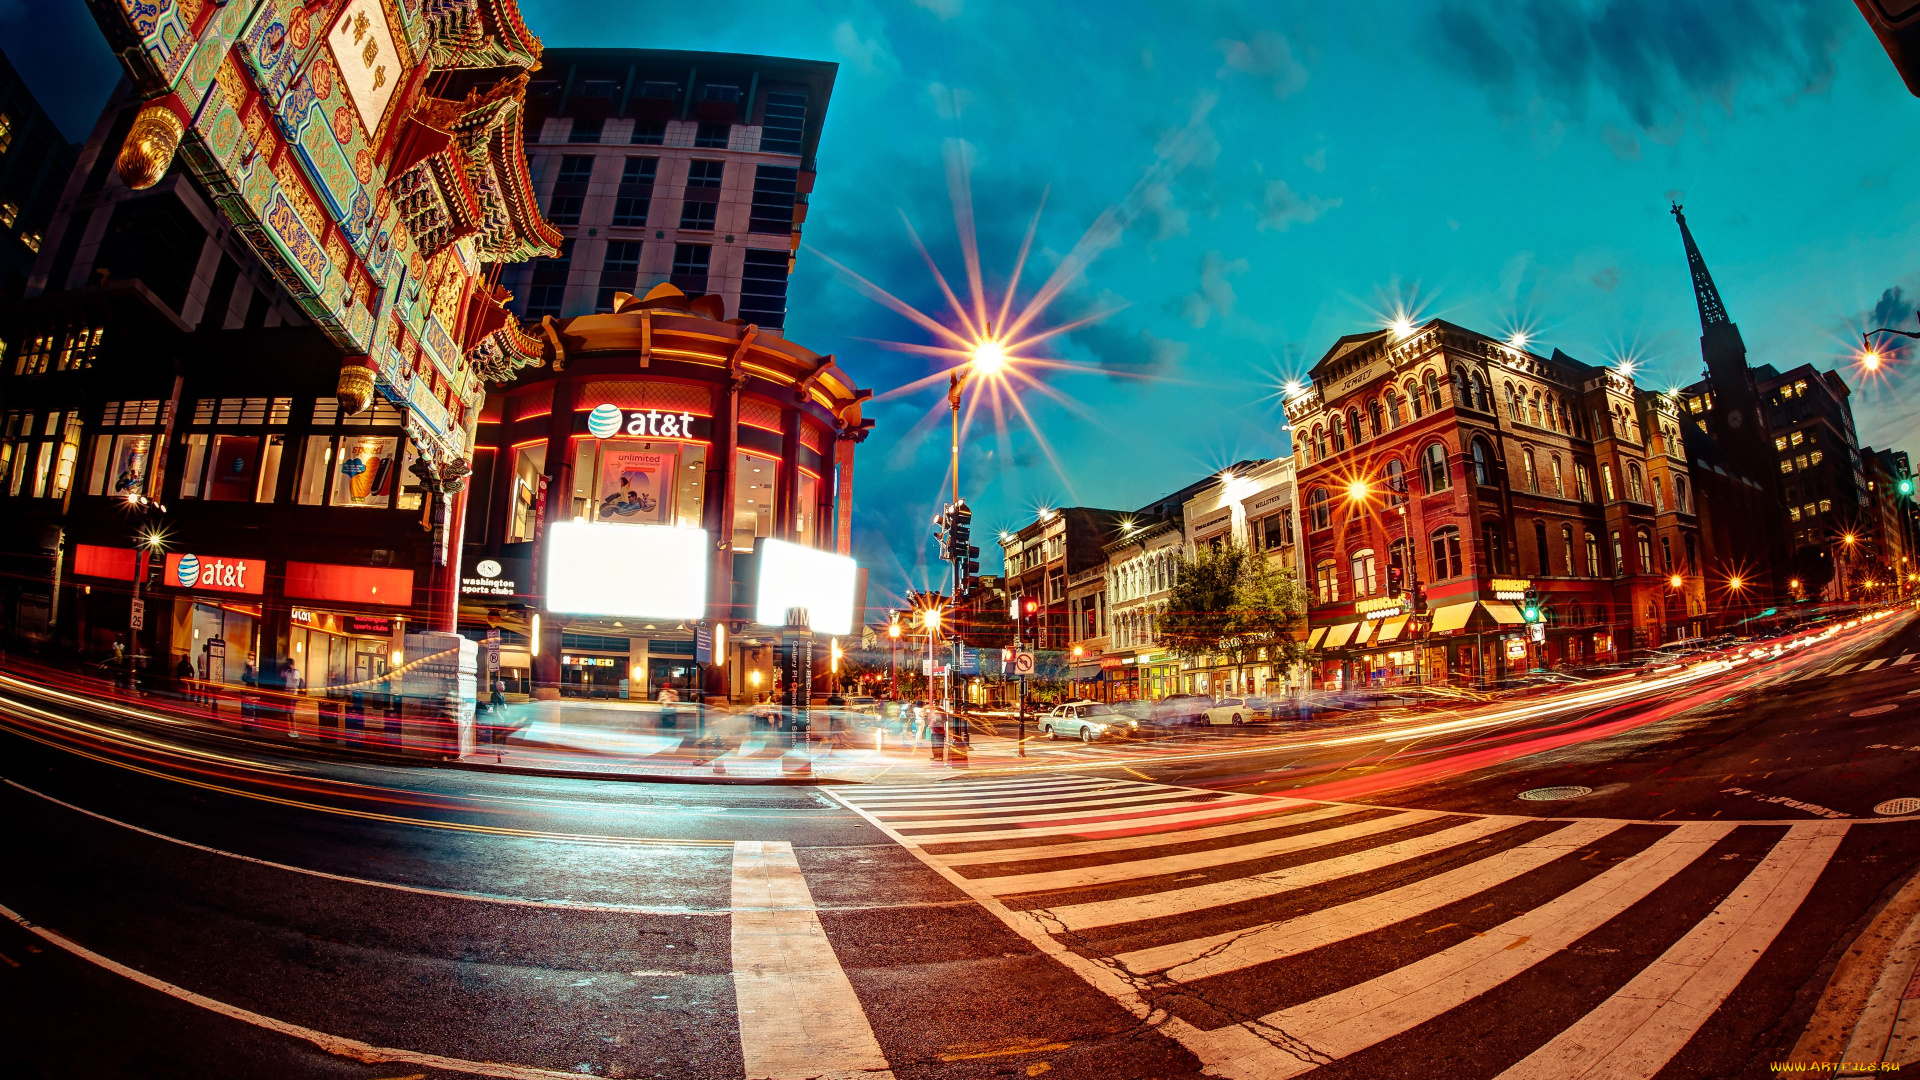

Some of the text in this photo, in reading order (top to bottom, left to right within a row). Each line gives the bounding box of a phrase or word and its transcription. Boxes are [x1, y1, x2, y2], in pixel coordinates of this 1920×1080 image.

[627, 408, 694, 439] at&t
[618, 454, 660, 463] unlimited
[202, 559, 247, 589] at&t
[462, 578, 515, 588] washington
[462, 586, 514, 596] sports clubs
[132, 615, 142, 628] 25
[372, 624, 389, 632] clubs
[570, 656, 615, 667] ZENGO
